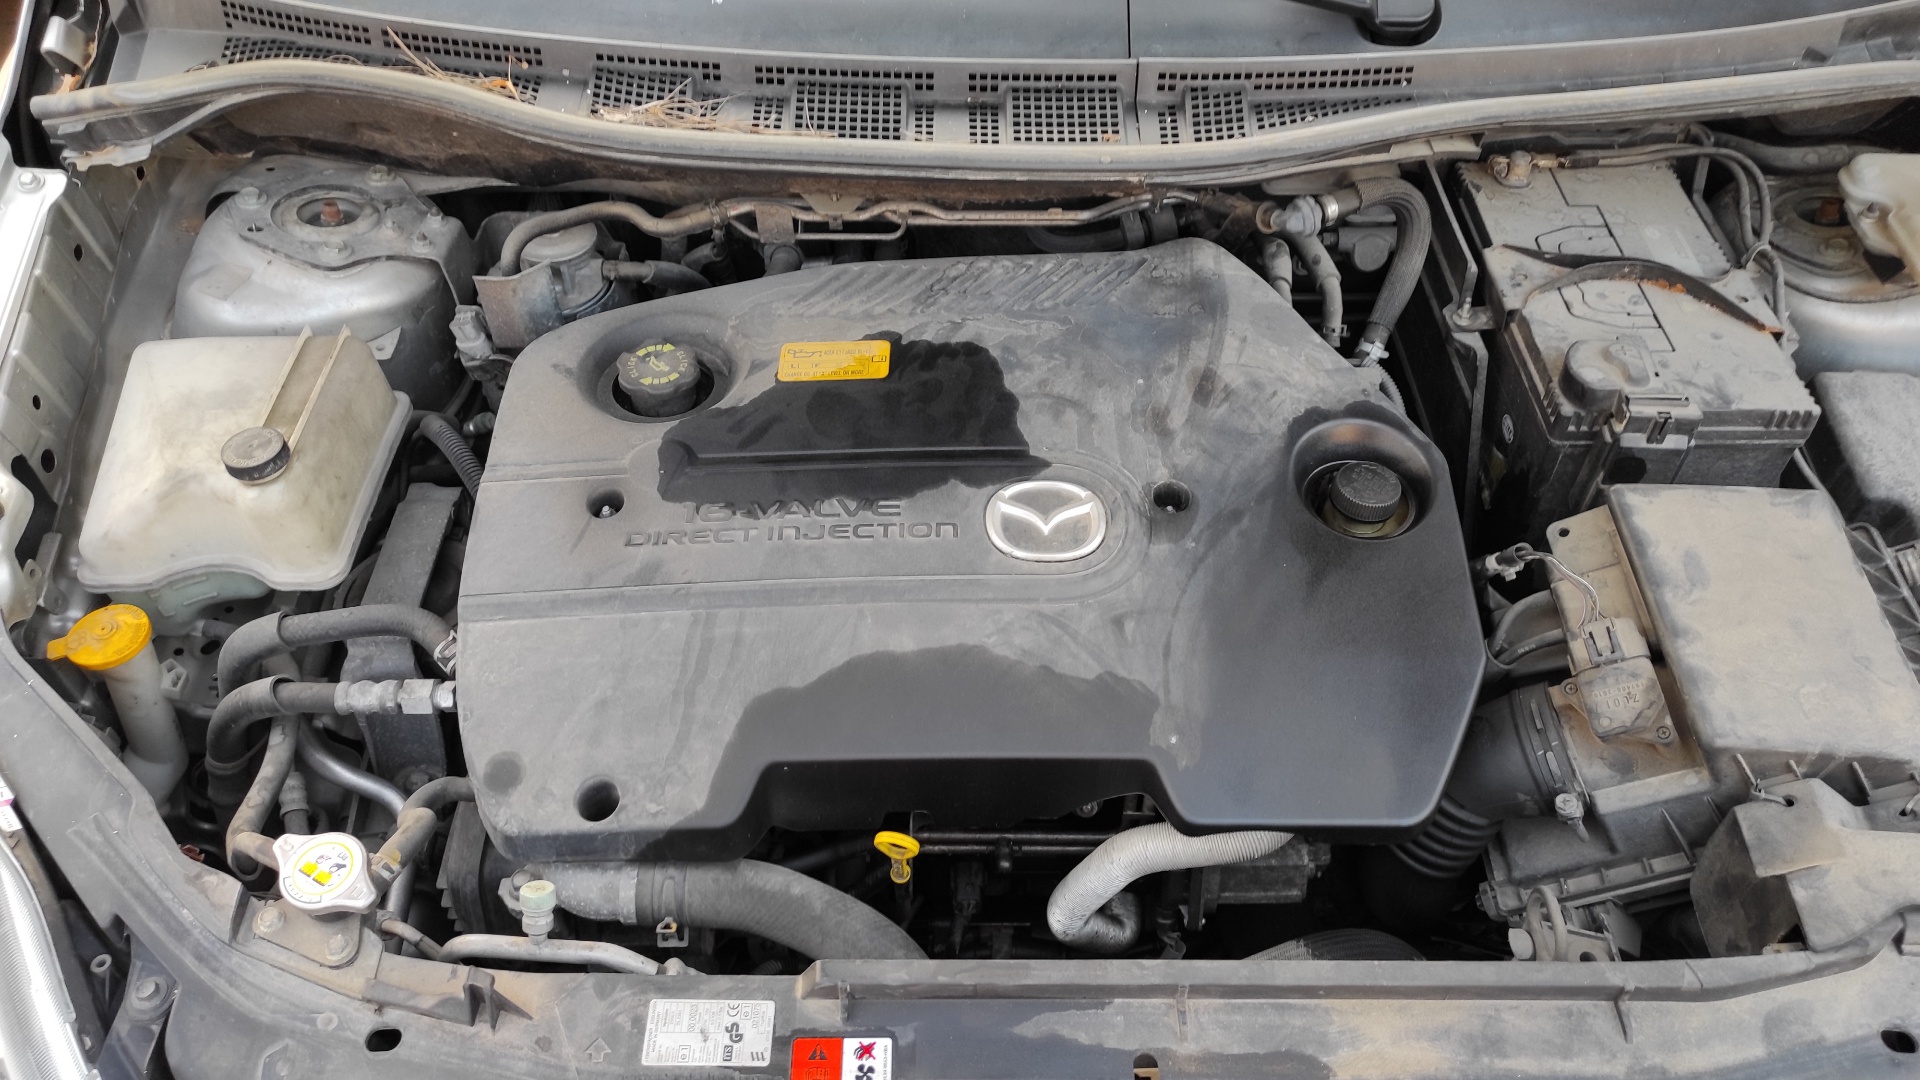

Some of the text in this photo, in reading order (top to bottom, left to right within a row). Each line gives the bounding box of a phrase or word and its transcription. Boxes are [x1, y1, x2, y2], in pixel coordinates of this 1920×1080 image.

[627, 356, 638, 378] CLICK
[676, 350, 688, 372] CLICK
[679, 498, 902, 524] 16-VALVE
[624, 520, 959, 548] DIRECT INJECTION
[726, 1002, 740, 1018] CE
[724, 1022, 743, 1044] GS
